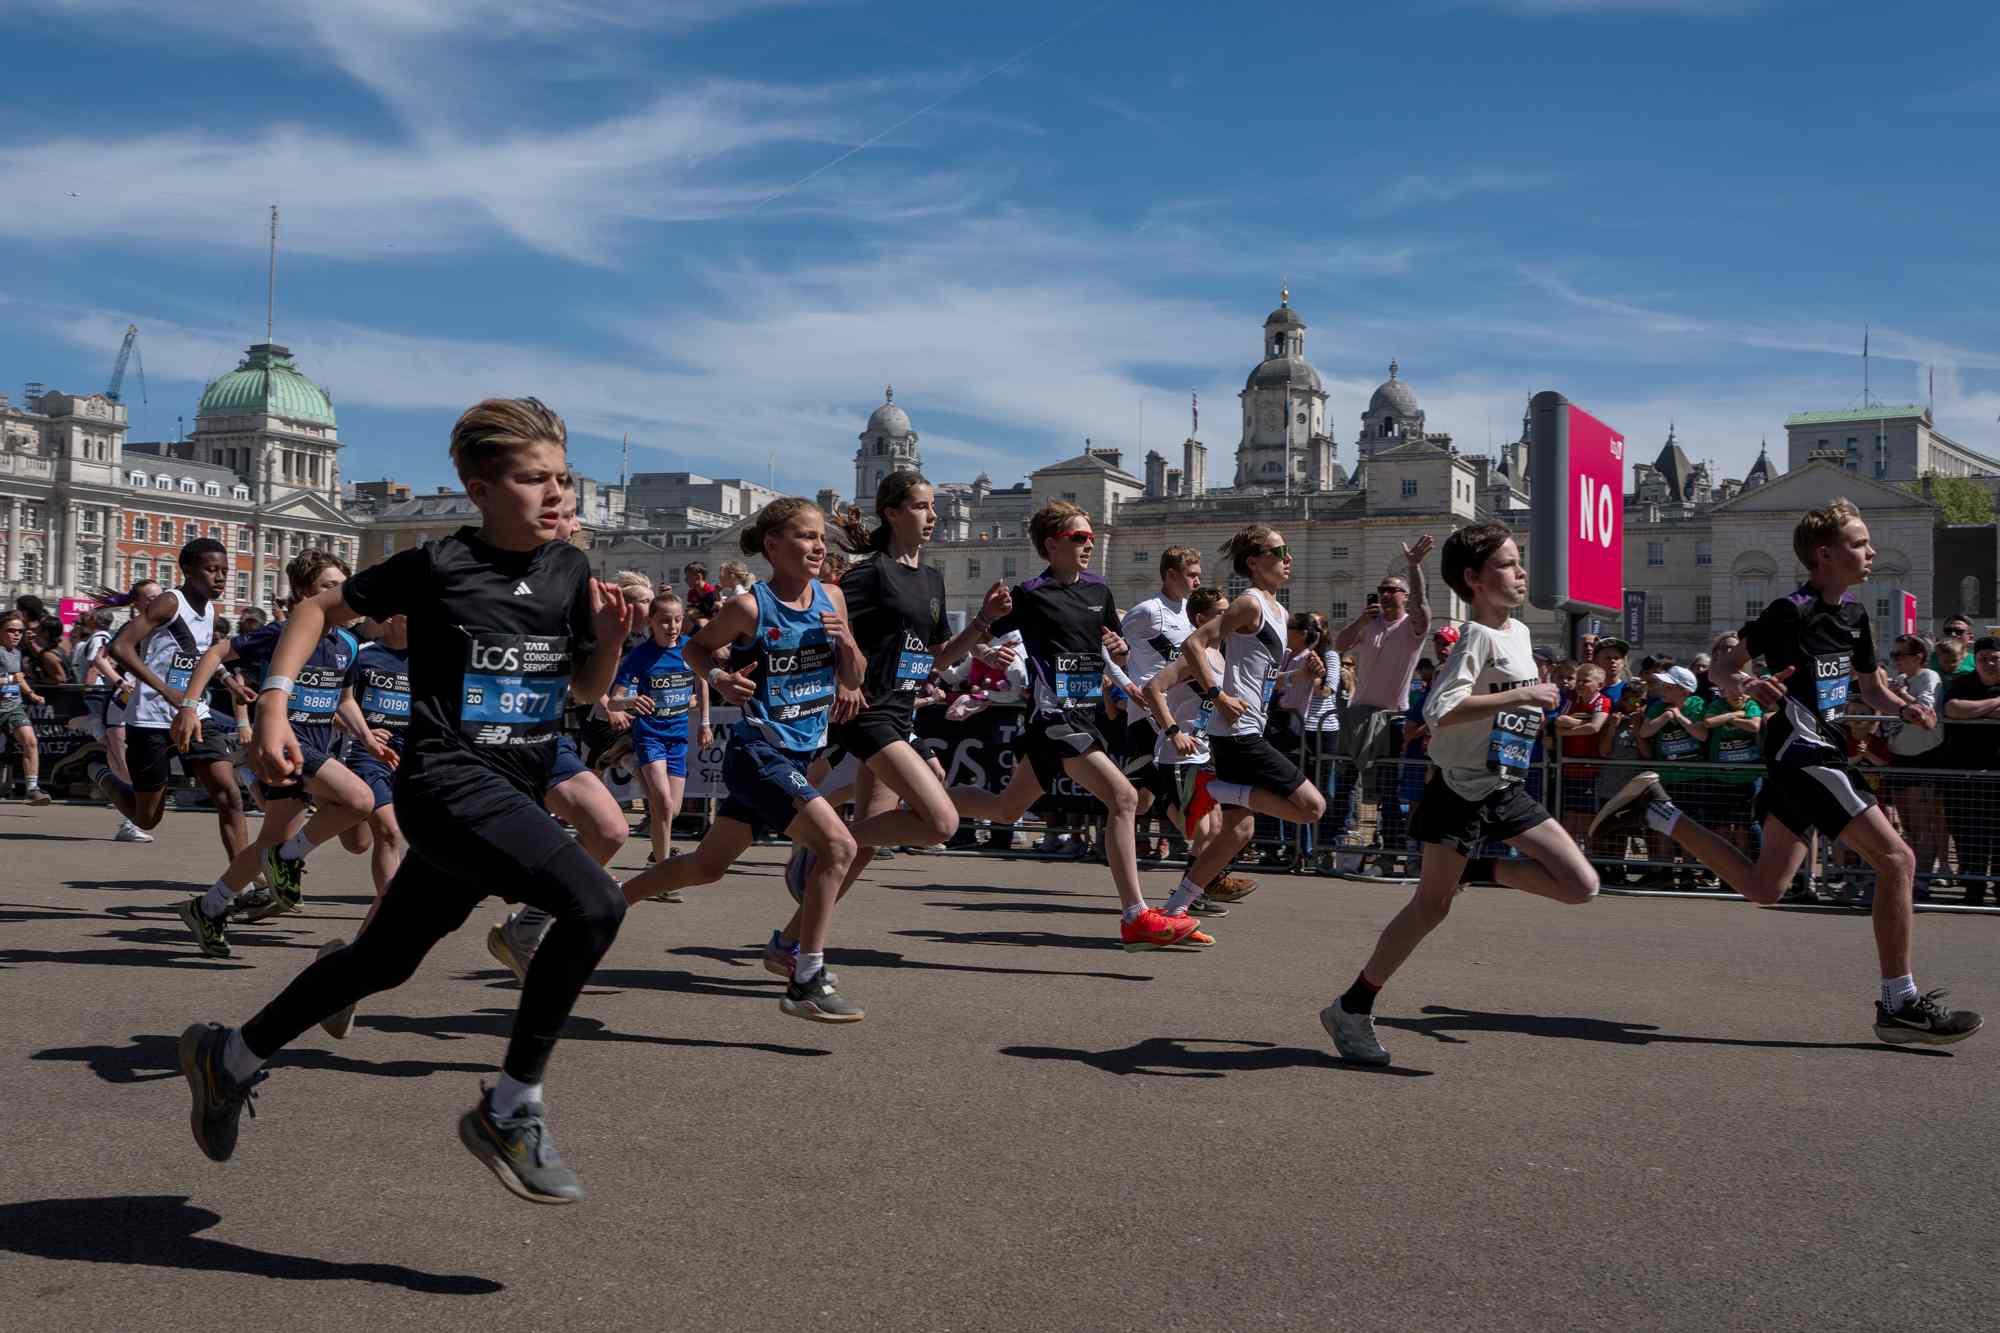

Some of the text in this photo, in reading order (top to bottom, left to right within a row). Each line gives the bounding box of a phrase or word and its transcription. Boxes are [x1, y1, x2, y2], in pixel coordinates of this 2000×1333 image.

[1579, 473, 1613, 549] NO
[523, 642, 550, 651] TATA
[904, 633, 924, 651] tcs
[175, 655, 193, 669] tcs
[471, 639, 519, 671] tcs
[768, 654, 799, 673] tcs
[522, 663, 558, 672] SERVICES
[1057, 656, 1078, 672] tcs
[1816, 660, 1838, 678] tcs
[369, 672, 393, 689] tcs
[651, 677, 670, 688] tcs
[378, 697, 409, 711] 10190
[467, 694, 482, 704] 20
[499, 692, 551, 713] 9977
[1497, 711, 1527, 733] tcs
